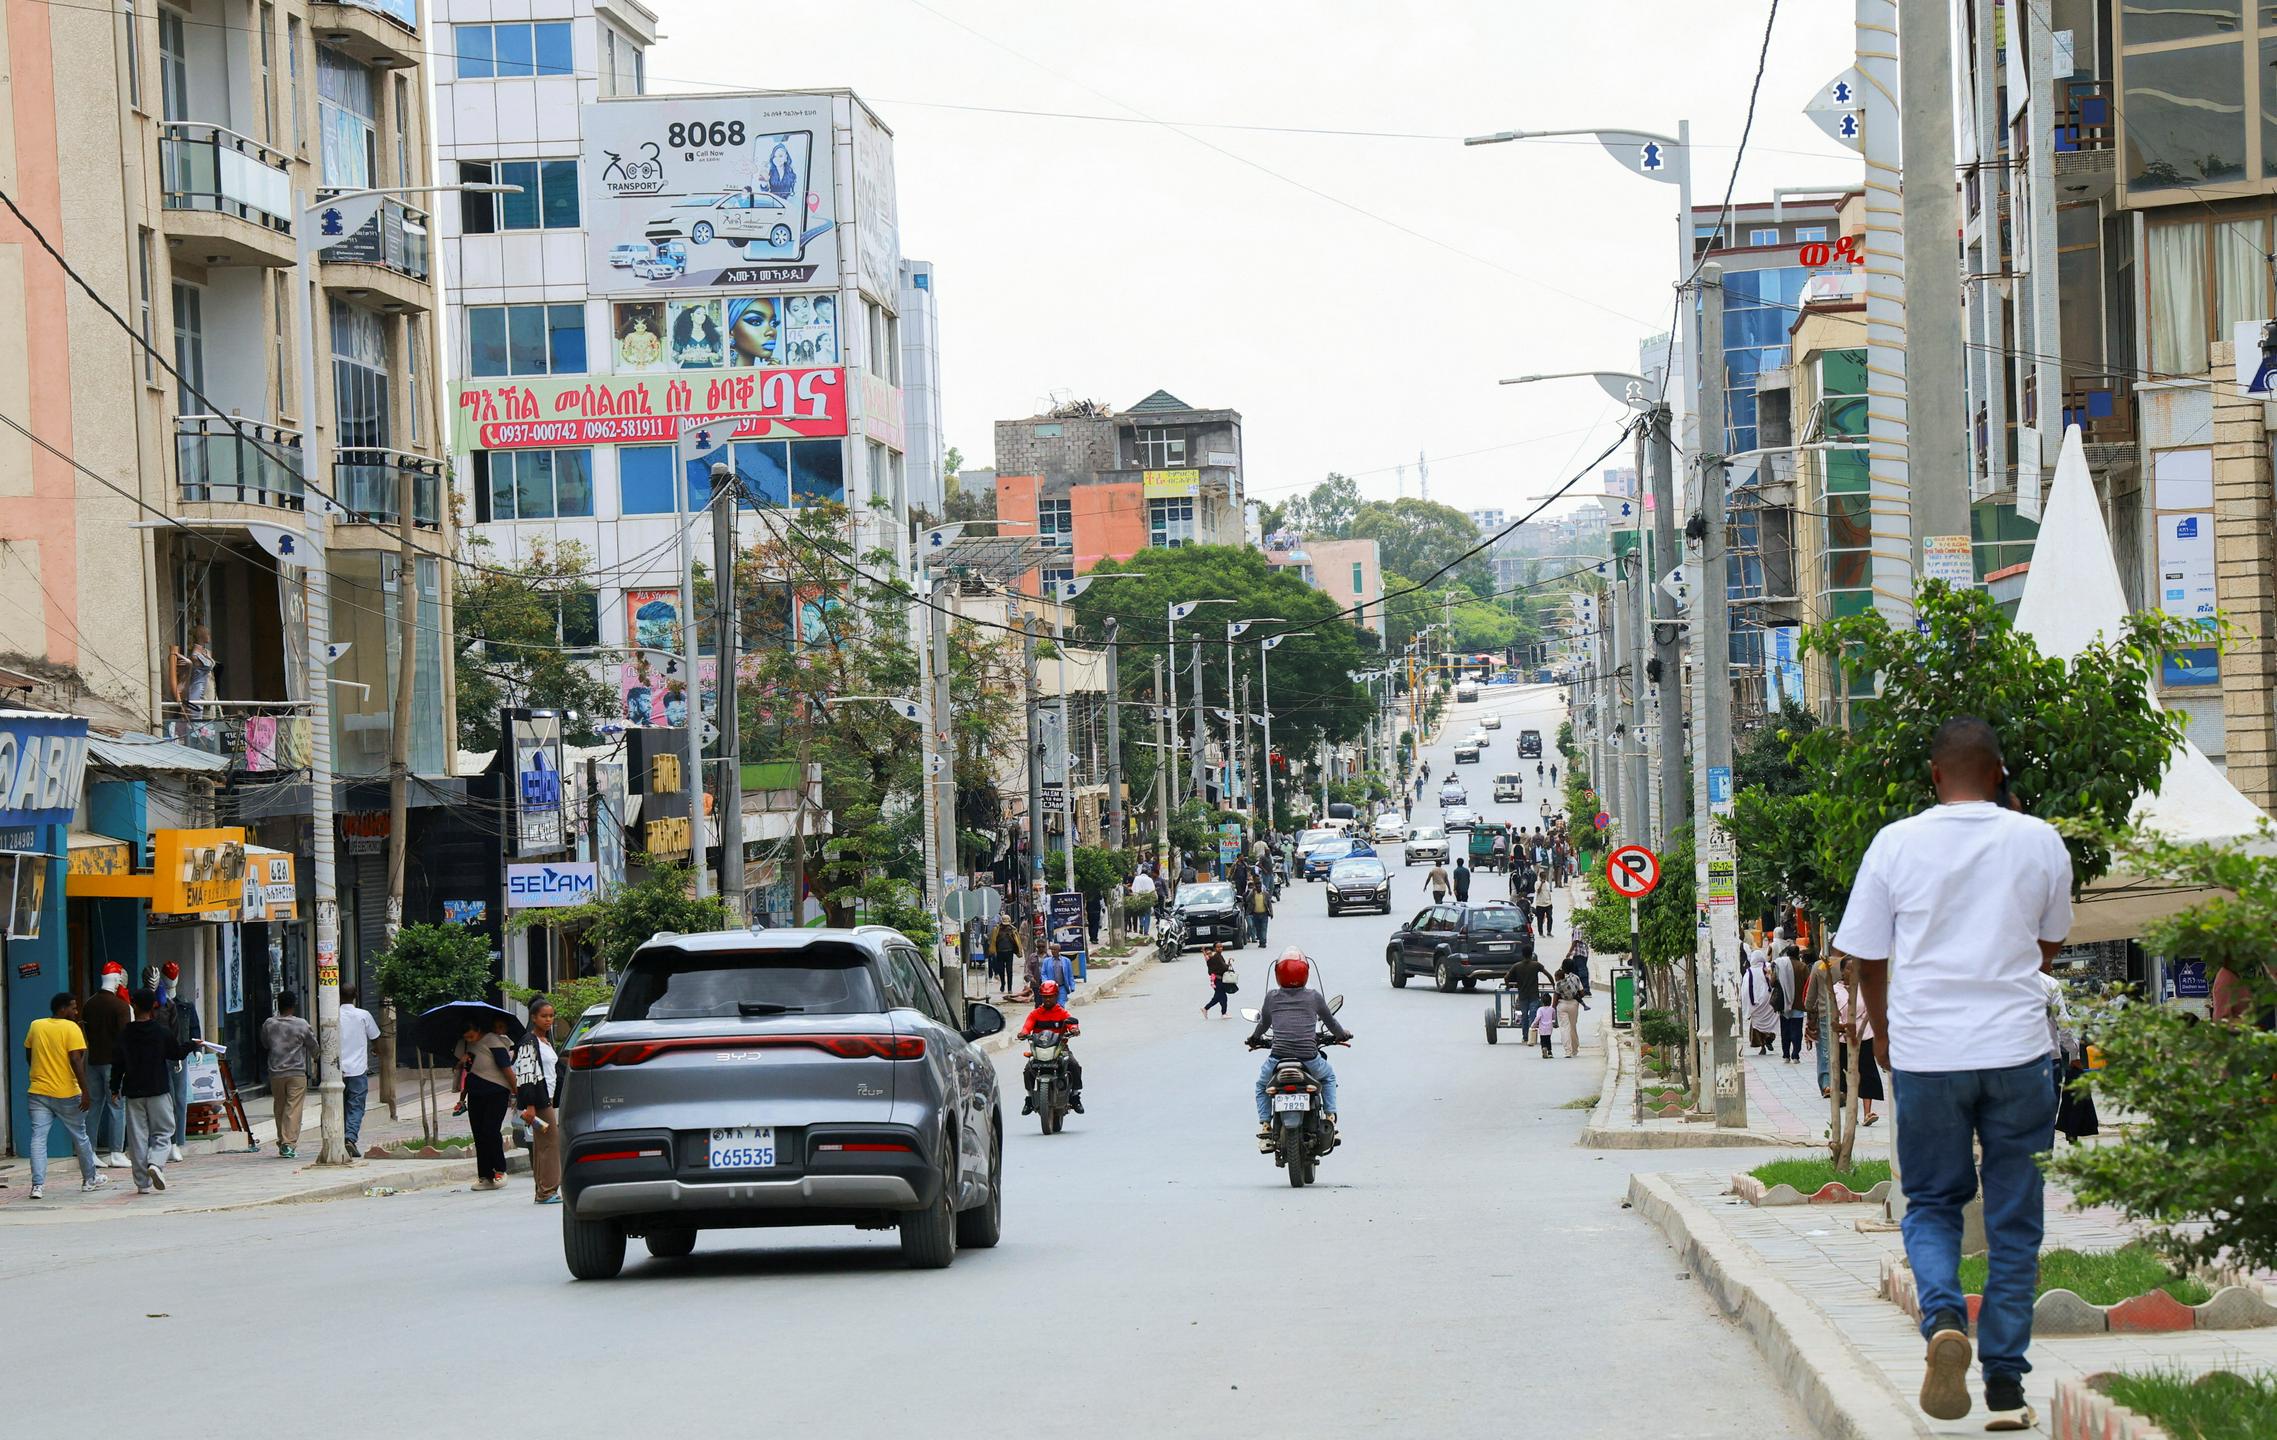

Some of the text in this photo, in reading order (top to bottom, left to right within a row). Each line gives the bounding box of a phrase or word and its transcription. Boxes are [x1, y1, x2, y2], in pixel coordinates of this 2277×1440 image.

[668, 120, 746, 148] 8068
[607, 182, 658, 191] TRANSPORT
[763, 370, 837, 421] ባና
[499, 422, 577, 443] 0937-000742
[2197, 603, 2214, 613] Ria
[511, 874, 593, 893] SELAM
[187, 886, 203, 907] EMA
[716, 1051, 761, 1061] BYD
[754, 1128, 771, 1139] AA
[712, 1147, 773, 1167] C65535
